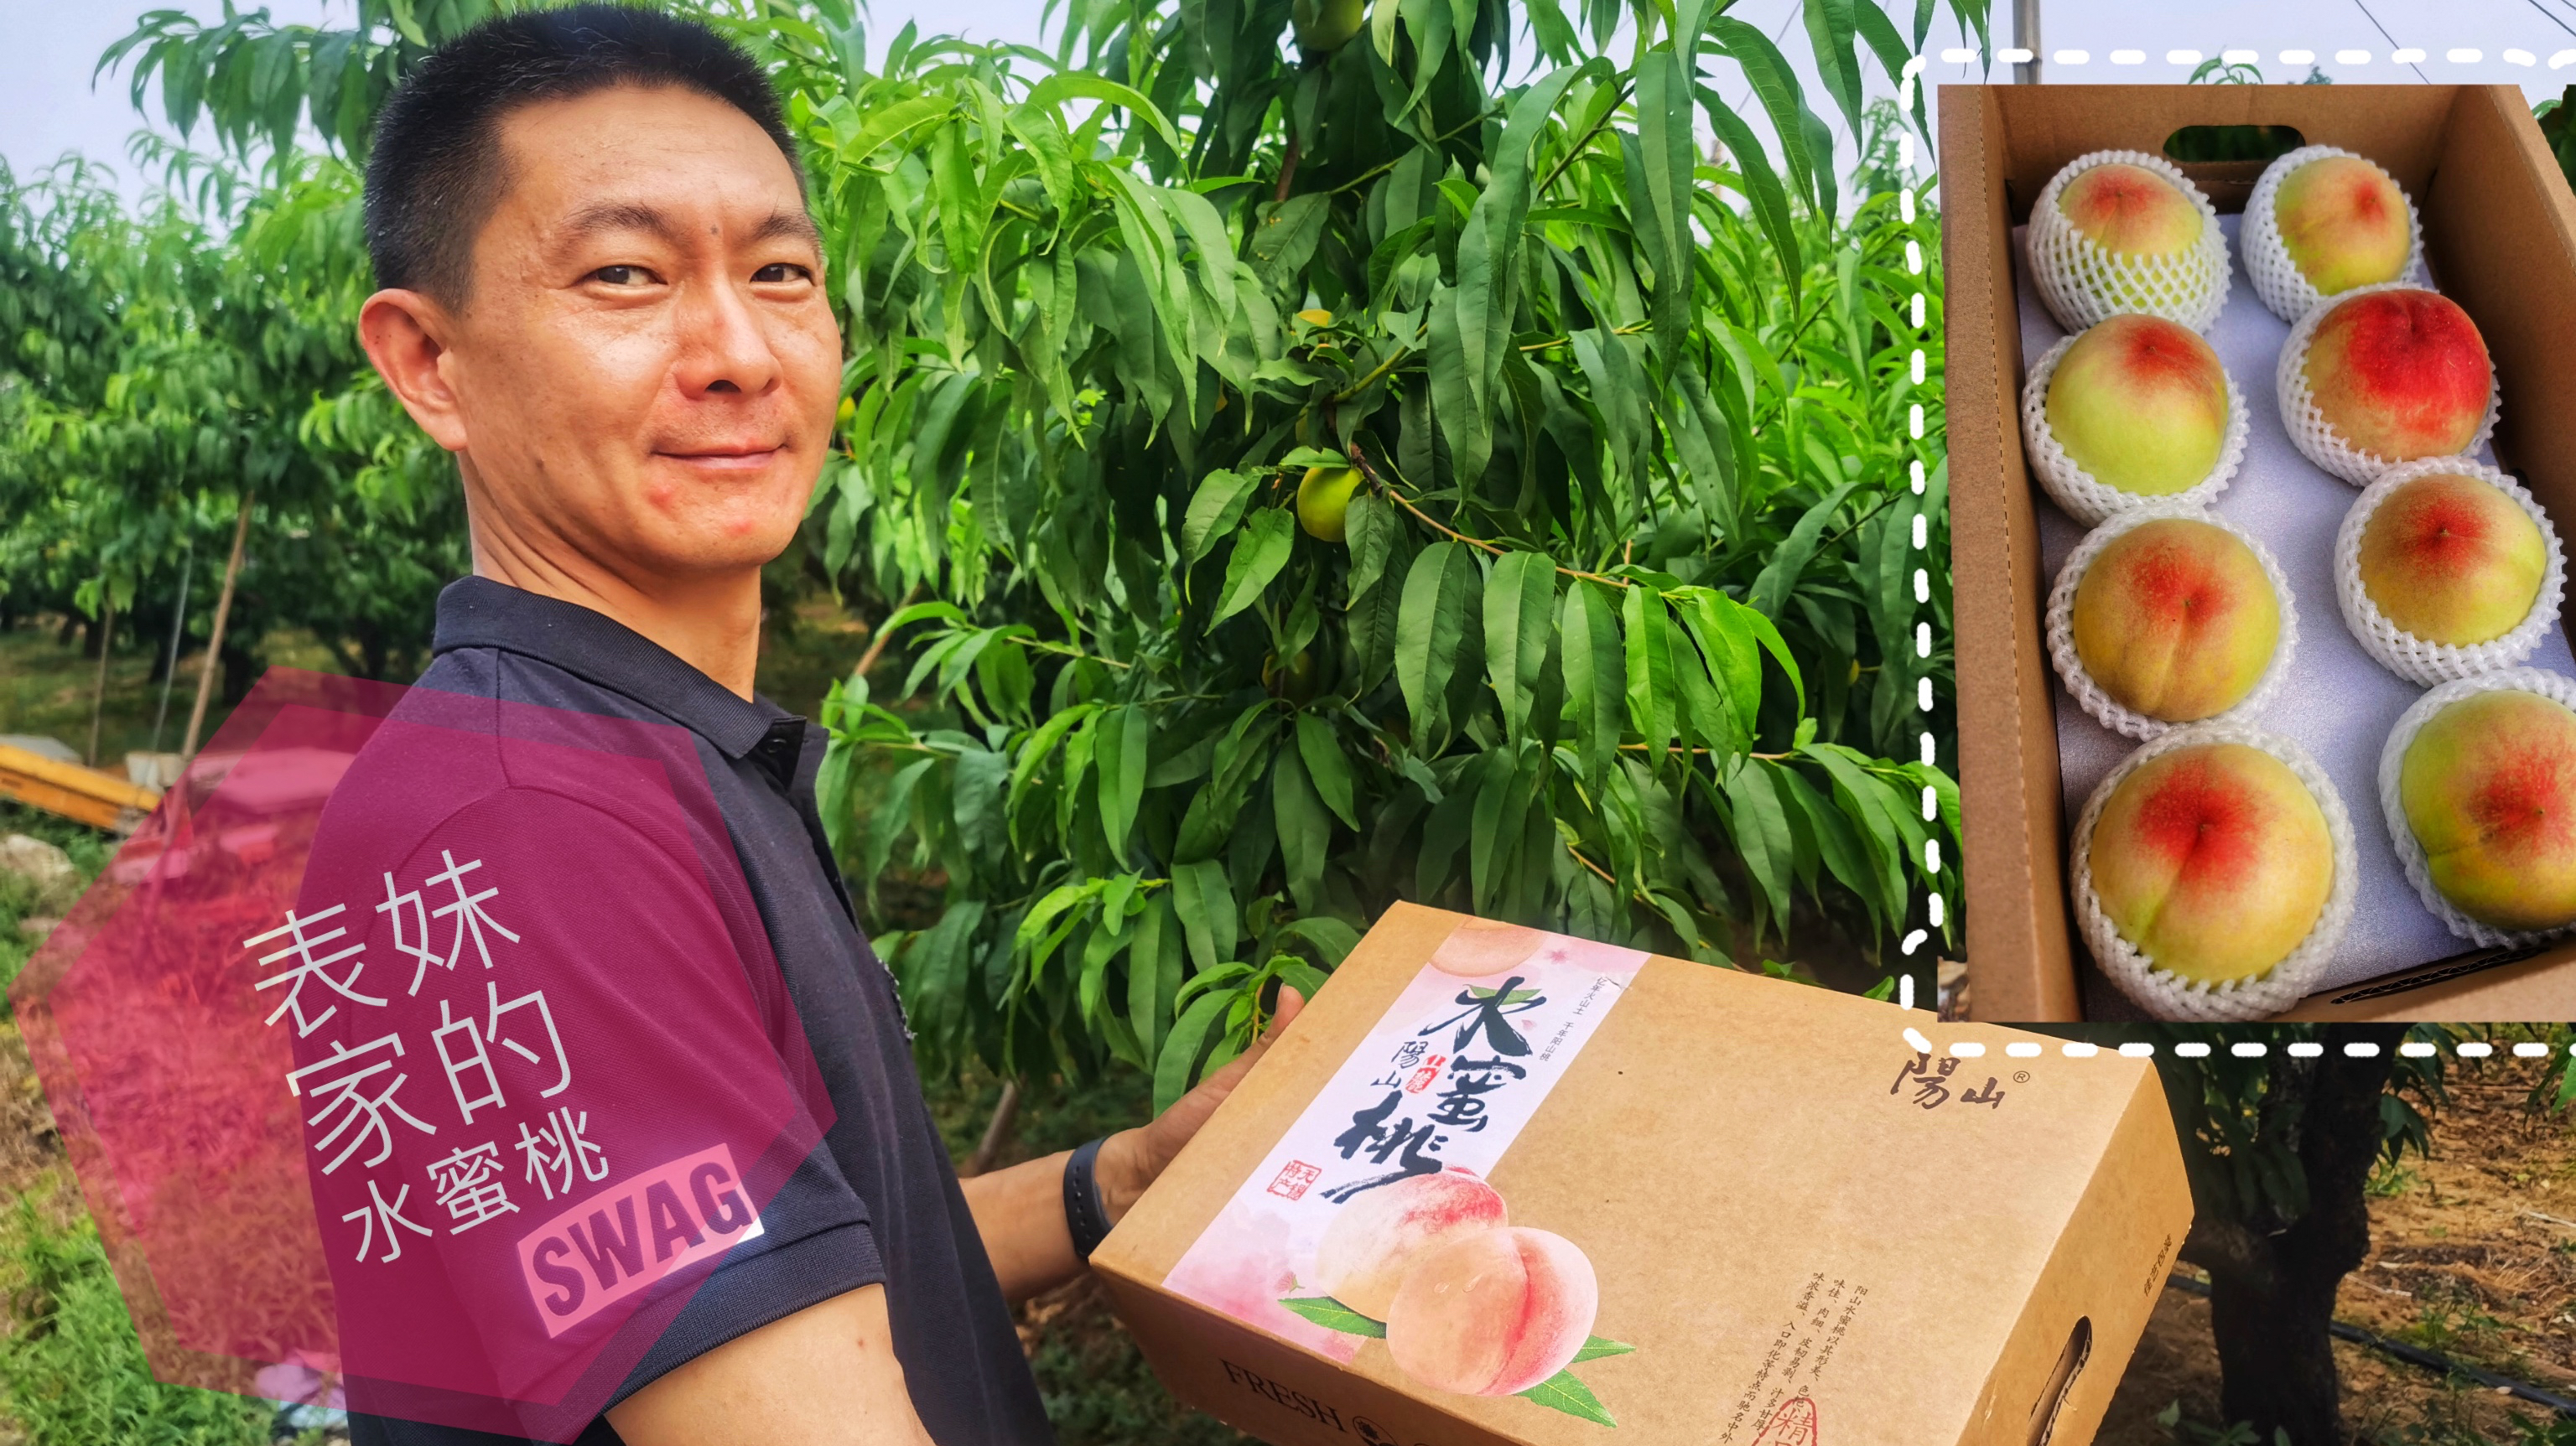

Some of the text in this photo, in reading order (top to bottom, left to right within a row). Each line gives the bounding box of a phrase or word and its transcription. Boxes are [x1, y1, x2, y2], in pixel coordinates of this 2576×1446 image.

[1318, 976, 1548, 1204] 水蜜桃
[532, 1161, 751, 1316] SWAG
[1220, 1358, 1348, 1433] FRESH
[1771, 1407, 1814, 1446] 精
